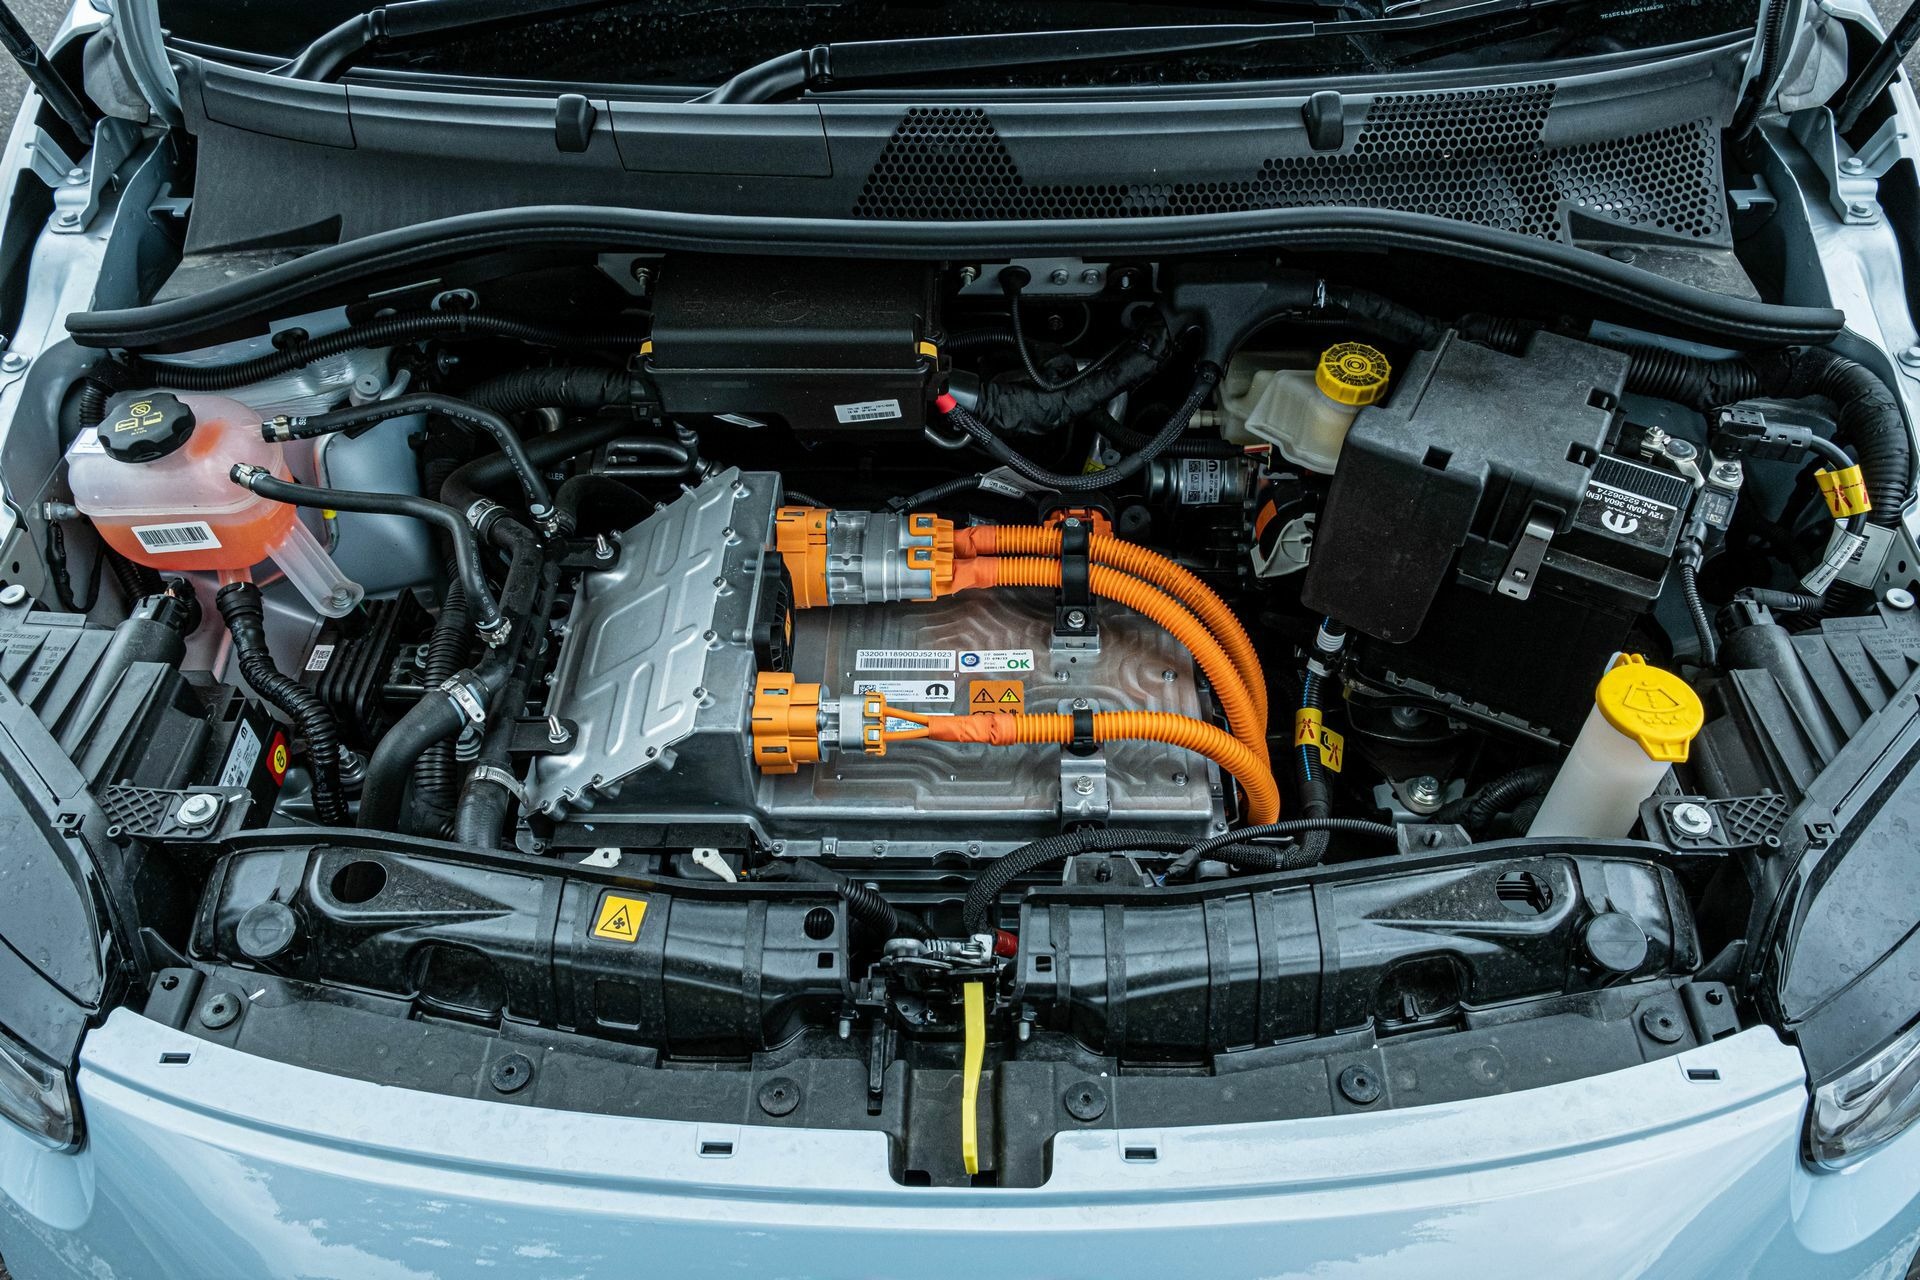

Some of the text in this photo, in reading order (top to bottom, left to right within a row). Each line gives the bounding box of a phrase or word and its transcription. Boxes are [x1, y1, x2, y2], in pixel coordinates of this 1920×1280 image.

[1585, 490, 1664, 520] 12V 40Ah 360A (EN)
[1597, 488, 1658, 511] PN: 52206274
[1007, 659, 1030, 670] OK
